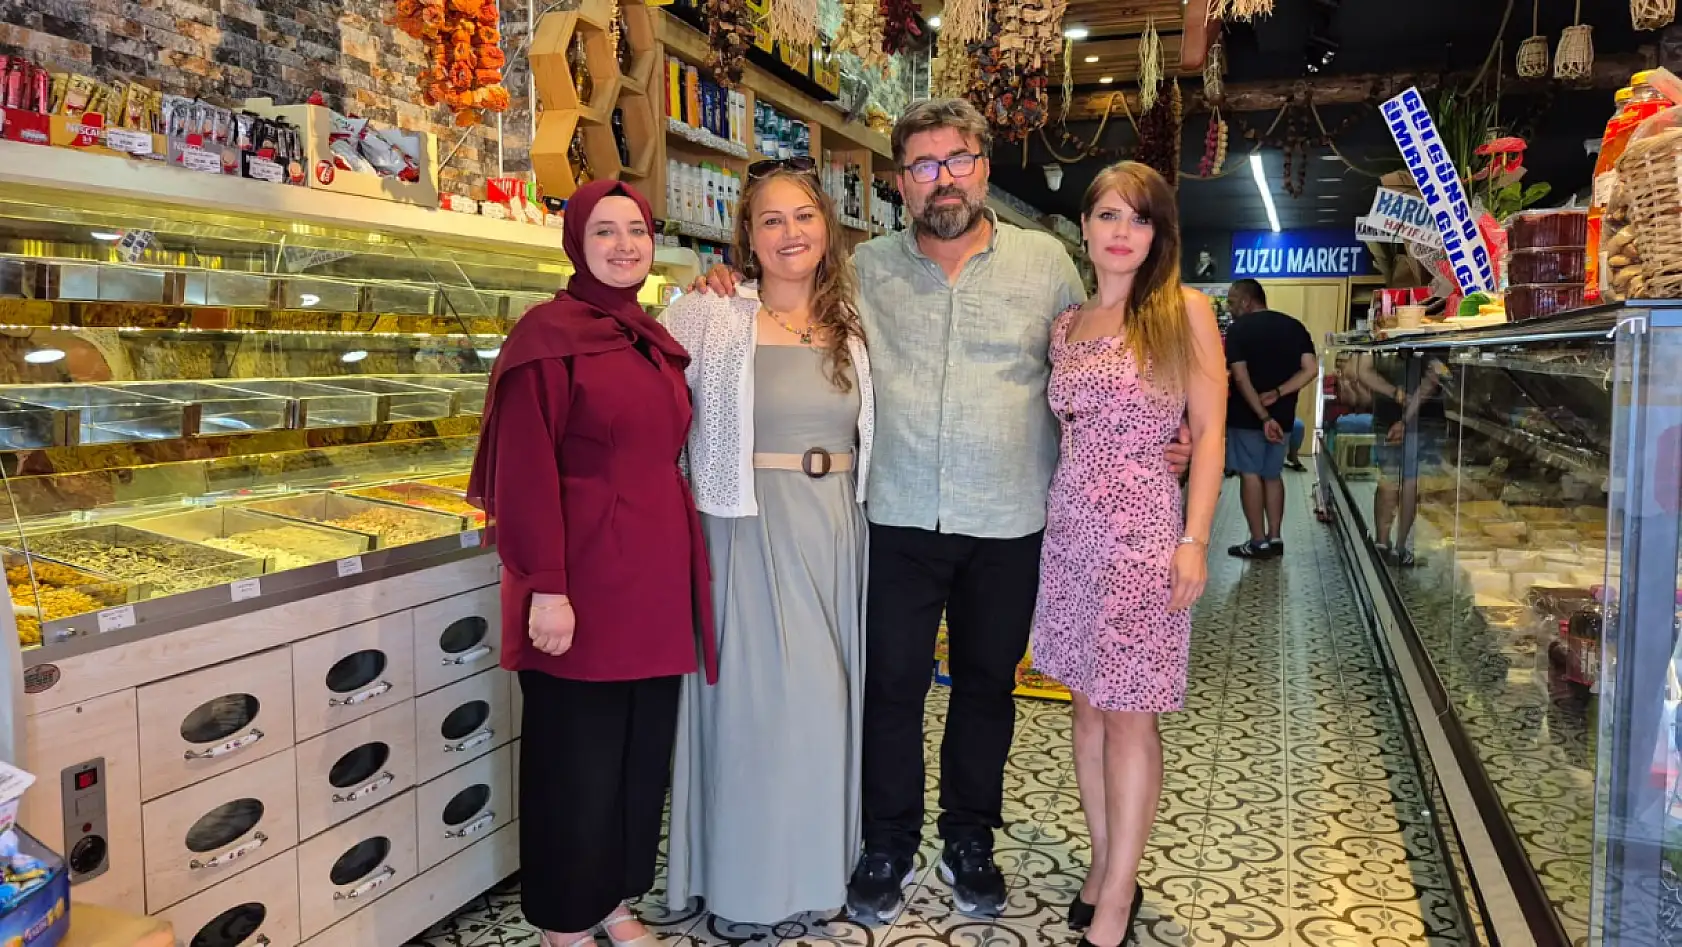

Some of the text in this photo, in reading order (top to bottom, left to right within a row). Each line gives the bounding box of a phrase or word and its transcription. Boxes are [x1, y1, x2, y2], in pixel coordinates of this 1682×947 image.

[1383, 100, 1441, 206] ÜMRAN
[1234, 247, 1362, 274] ZUZU MARKET
